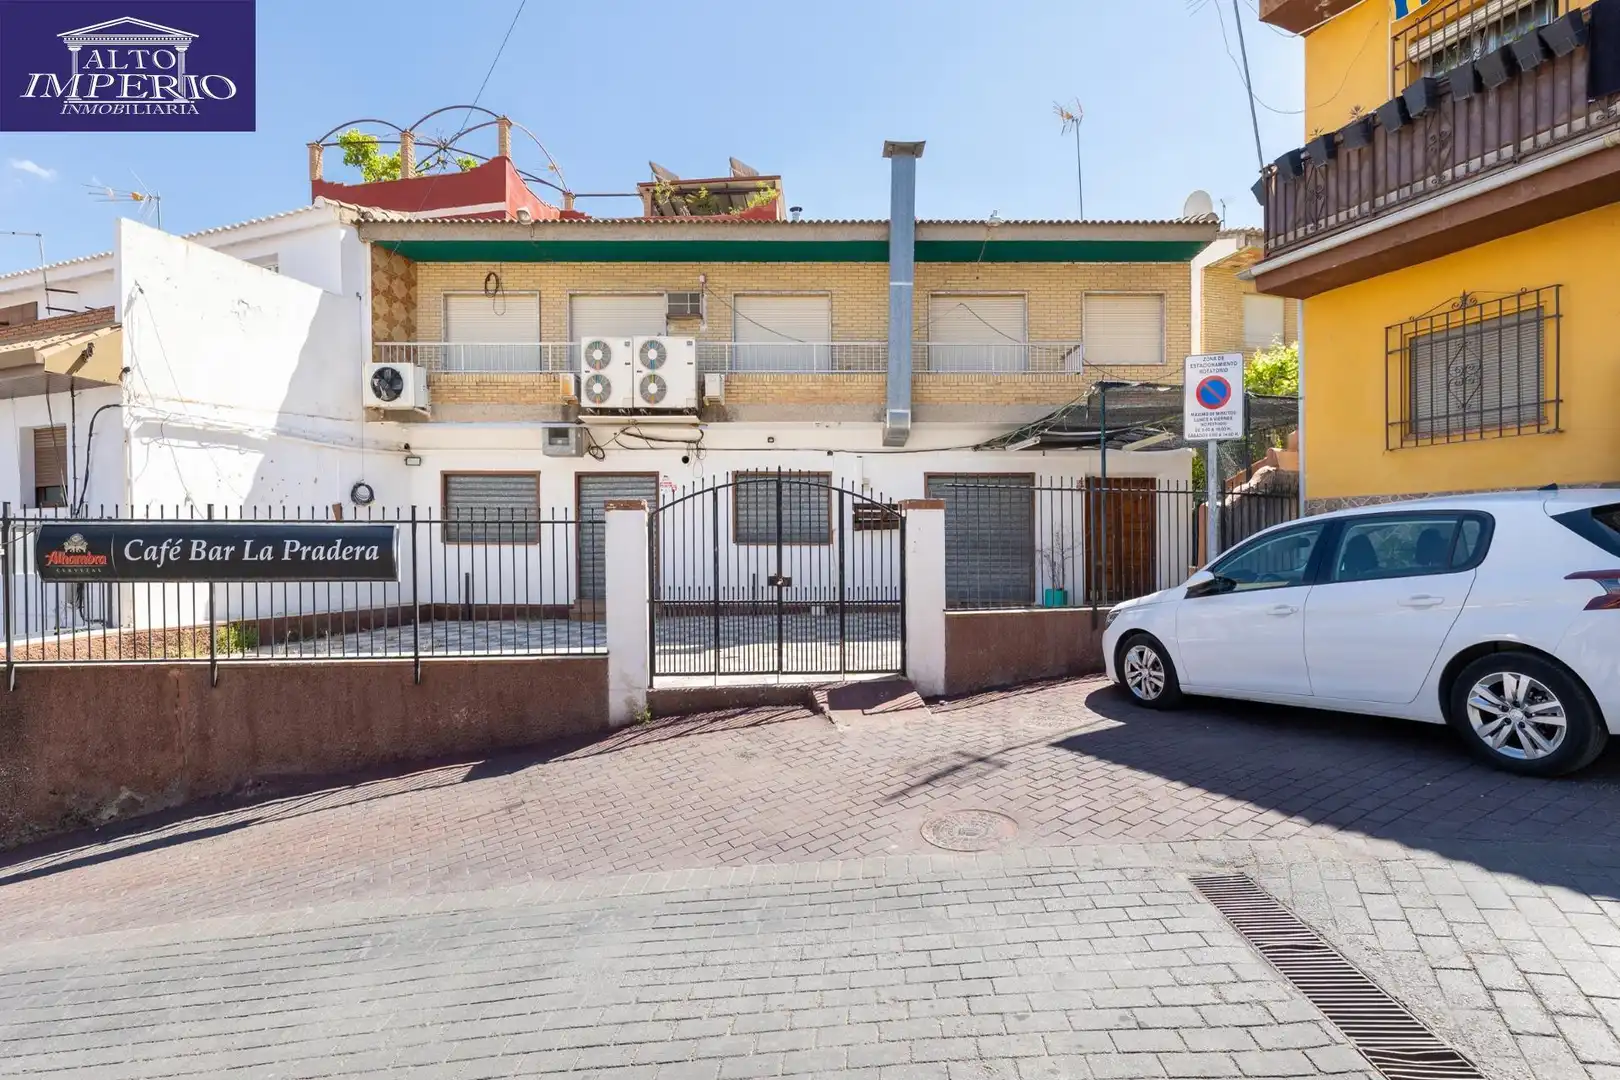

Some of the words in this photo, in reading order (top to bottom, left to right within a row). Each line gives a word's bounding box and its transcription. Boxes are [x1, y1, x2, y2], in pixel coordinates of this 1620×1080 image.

[44, 551, 107, 567] Alhambra
[124, 538, 183, 569] Café
[189, 539, 235, 561] Bar
[242, 539, 274, 561] La
[281, 538, 380, 561] Pradera
